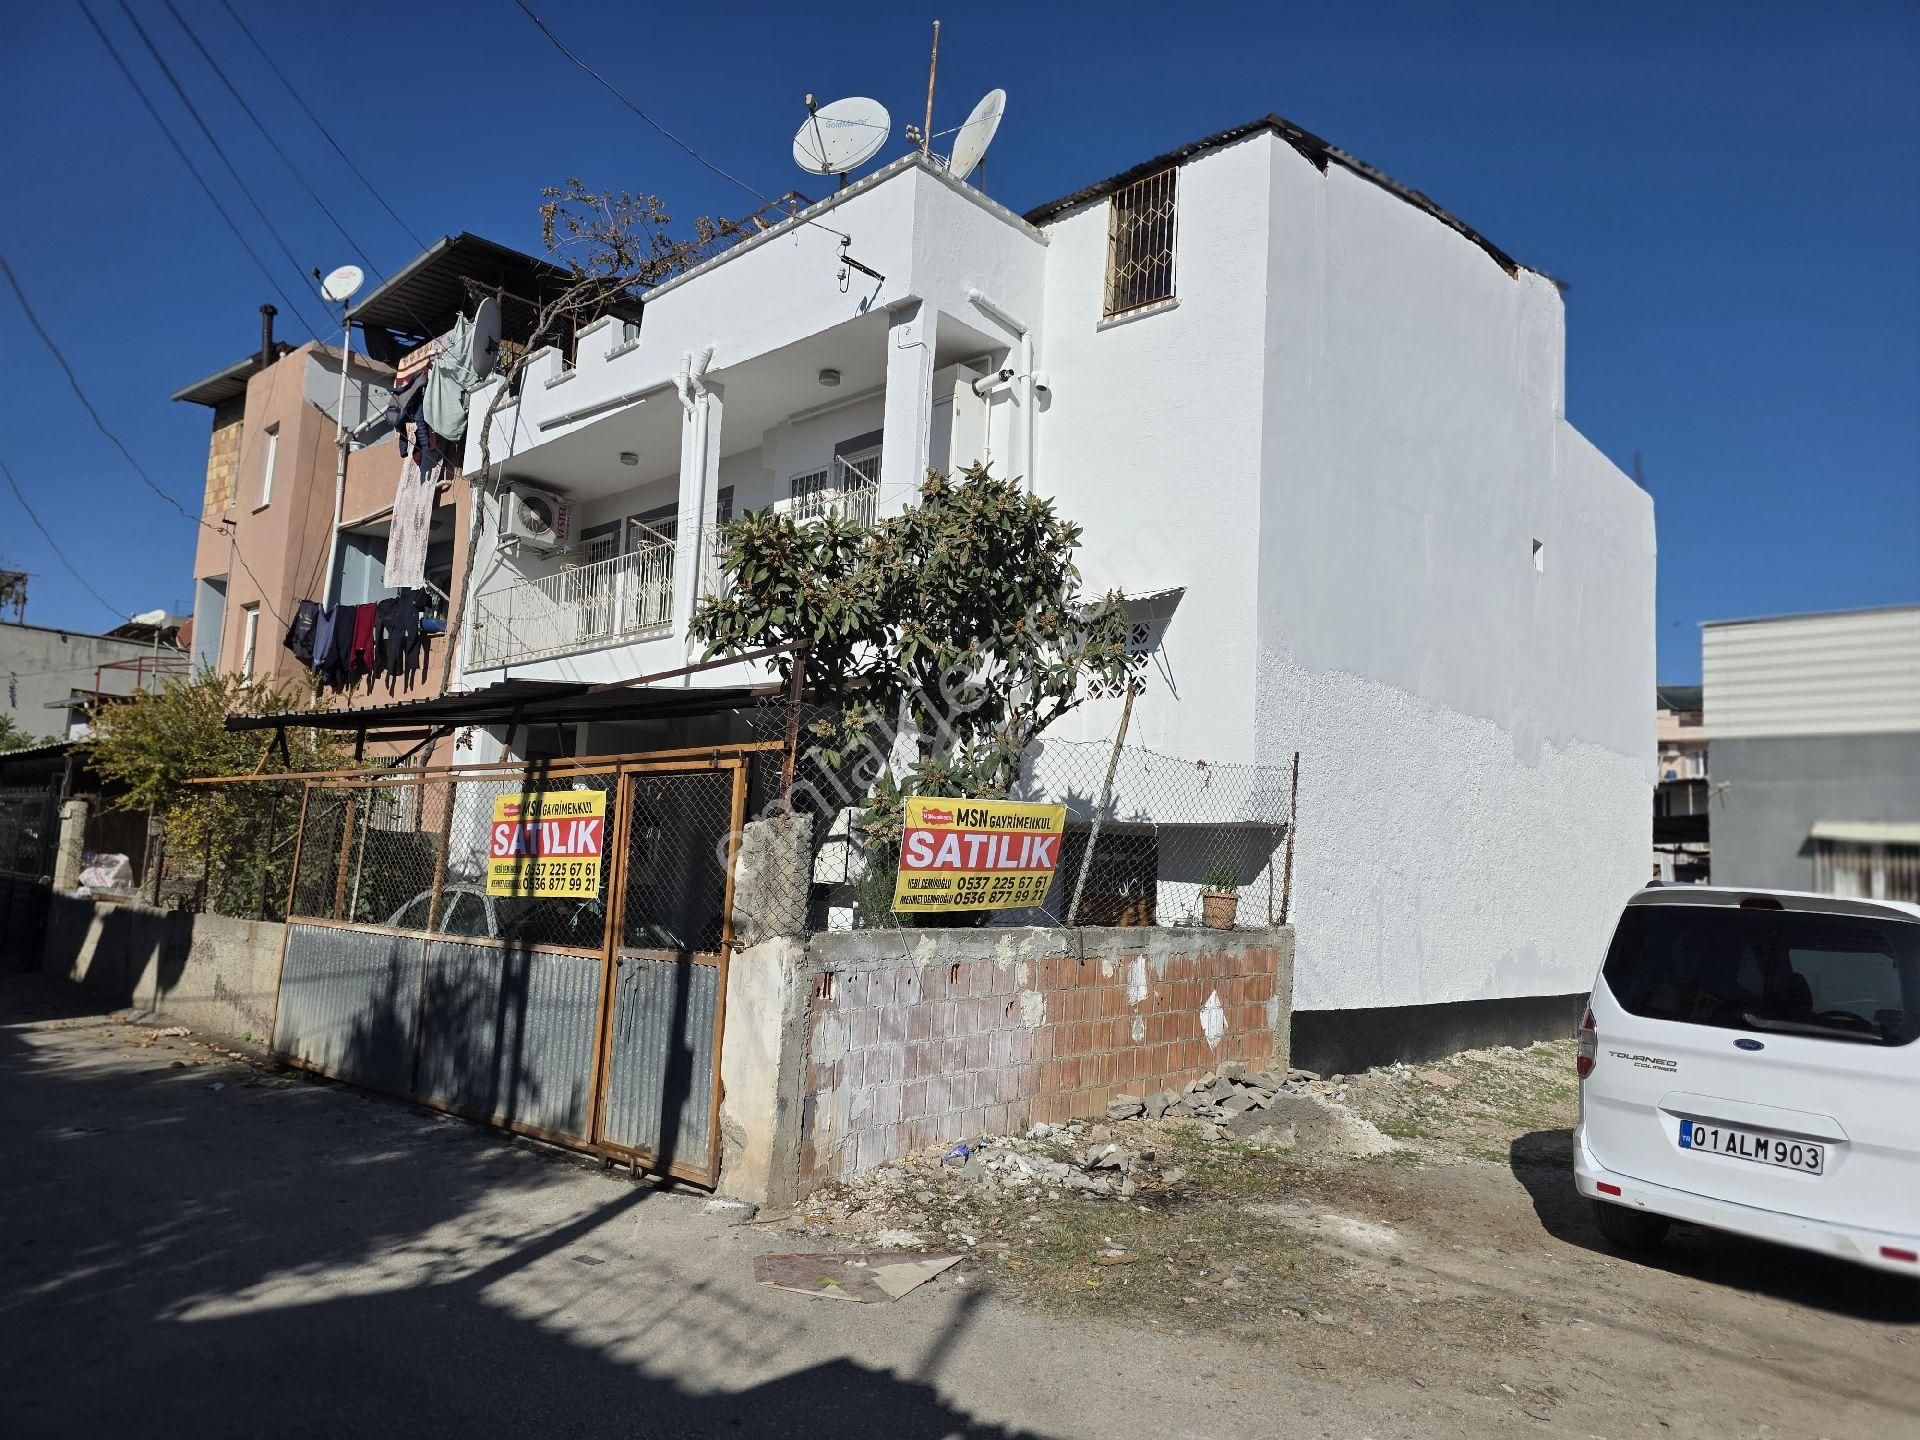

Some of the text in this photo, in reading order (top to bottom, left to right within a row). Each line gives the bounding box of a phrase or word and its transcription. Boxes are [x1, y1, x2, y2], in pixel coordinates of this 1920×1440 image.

[824, 117, 870, 129] GoldMaster
[557, 504, 567, 540] VESTEL
[522, 800, 543, 817] MSN
[956, 807, 989, 828] MSN
[989, 813, 1051, 830] GAYRİMENKUL
[493, 819, 600, 856] SATILIK
[906, 830, 1057, 869] SATILIK
[524, 863, 547, 876] 0537
[550, 863, 566, 876] 225
[570, 863, 582, 876] 67
[586, 863, 596, 876] 61
[523, 878, 546, 891] 0536
[548, 878, 566, 891] 877
[569, 878, 582, 891] 99
[585, 878, 595, 891] 21
[958, 876, 990, 890] 0537
[992, 876, 1015, 890] 225
[1018, 876, 1033, 888] 67
[1035, 876, 1048, 888] 61
[954, 891, 985, 906] 0536
[988, 891, 1011, 904] 877
[1014, 890, 1029, 903] 99
[1032, 889, 1044, 901] 21
[1608, 1050, 1677, 1067] TOURNEO
[1634, 1062, 1678, 1073] COURIER
[1682, 1126, 1820, 1170] TR 01 ALM 903
